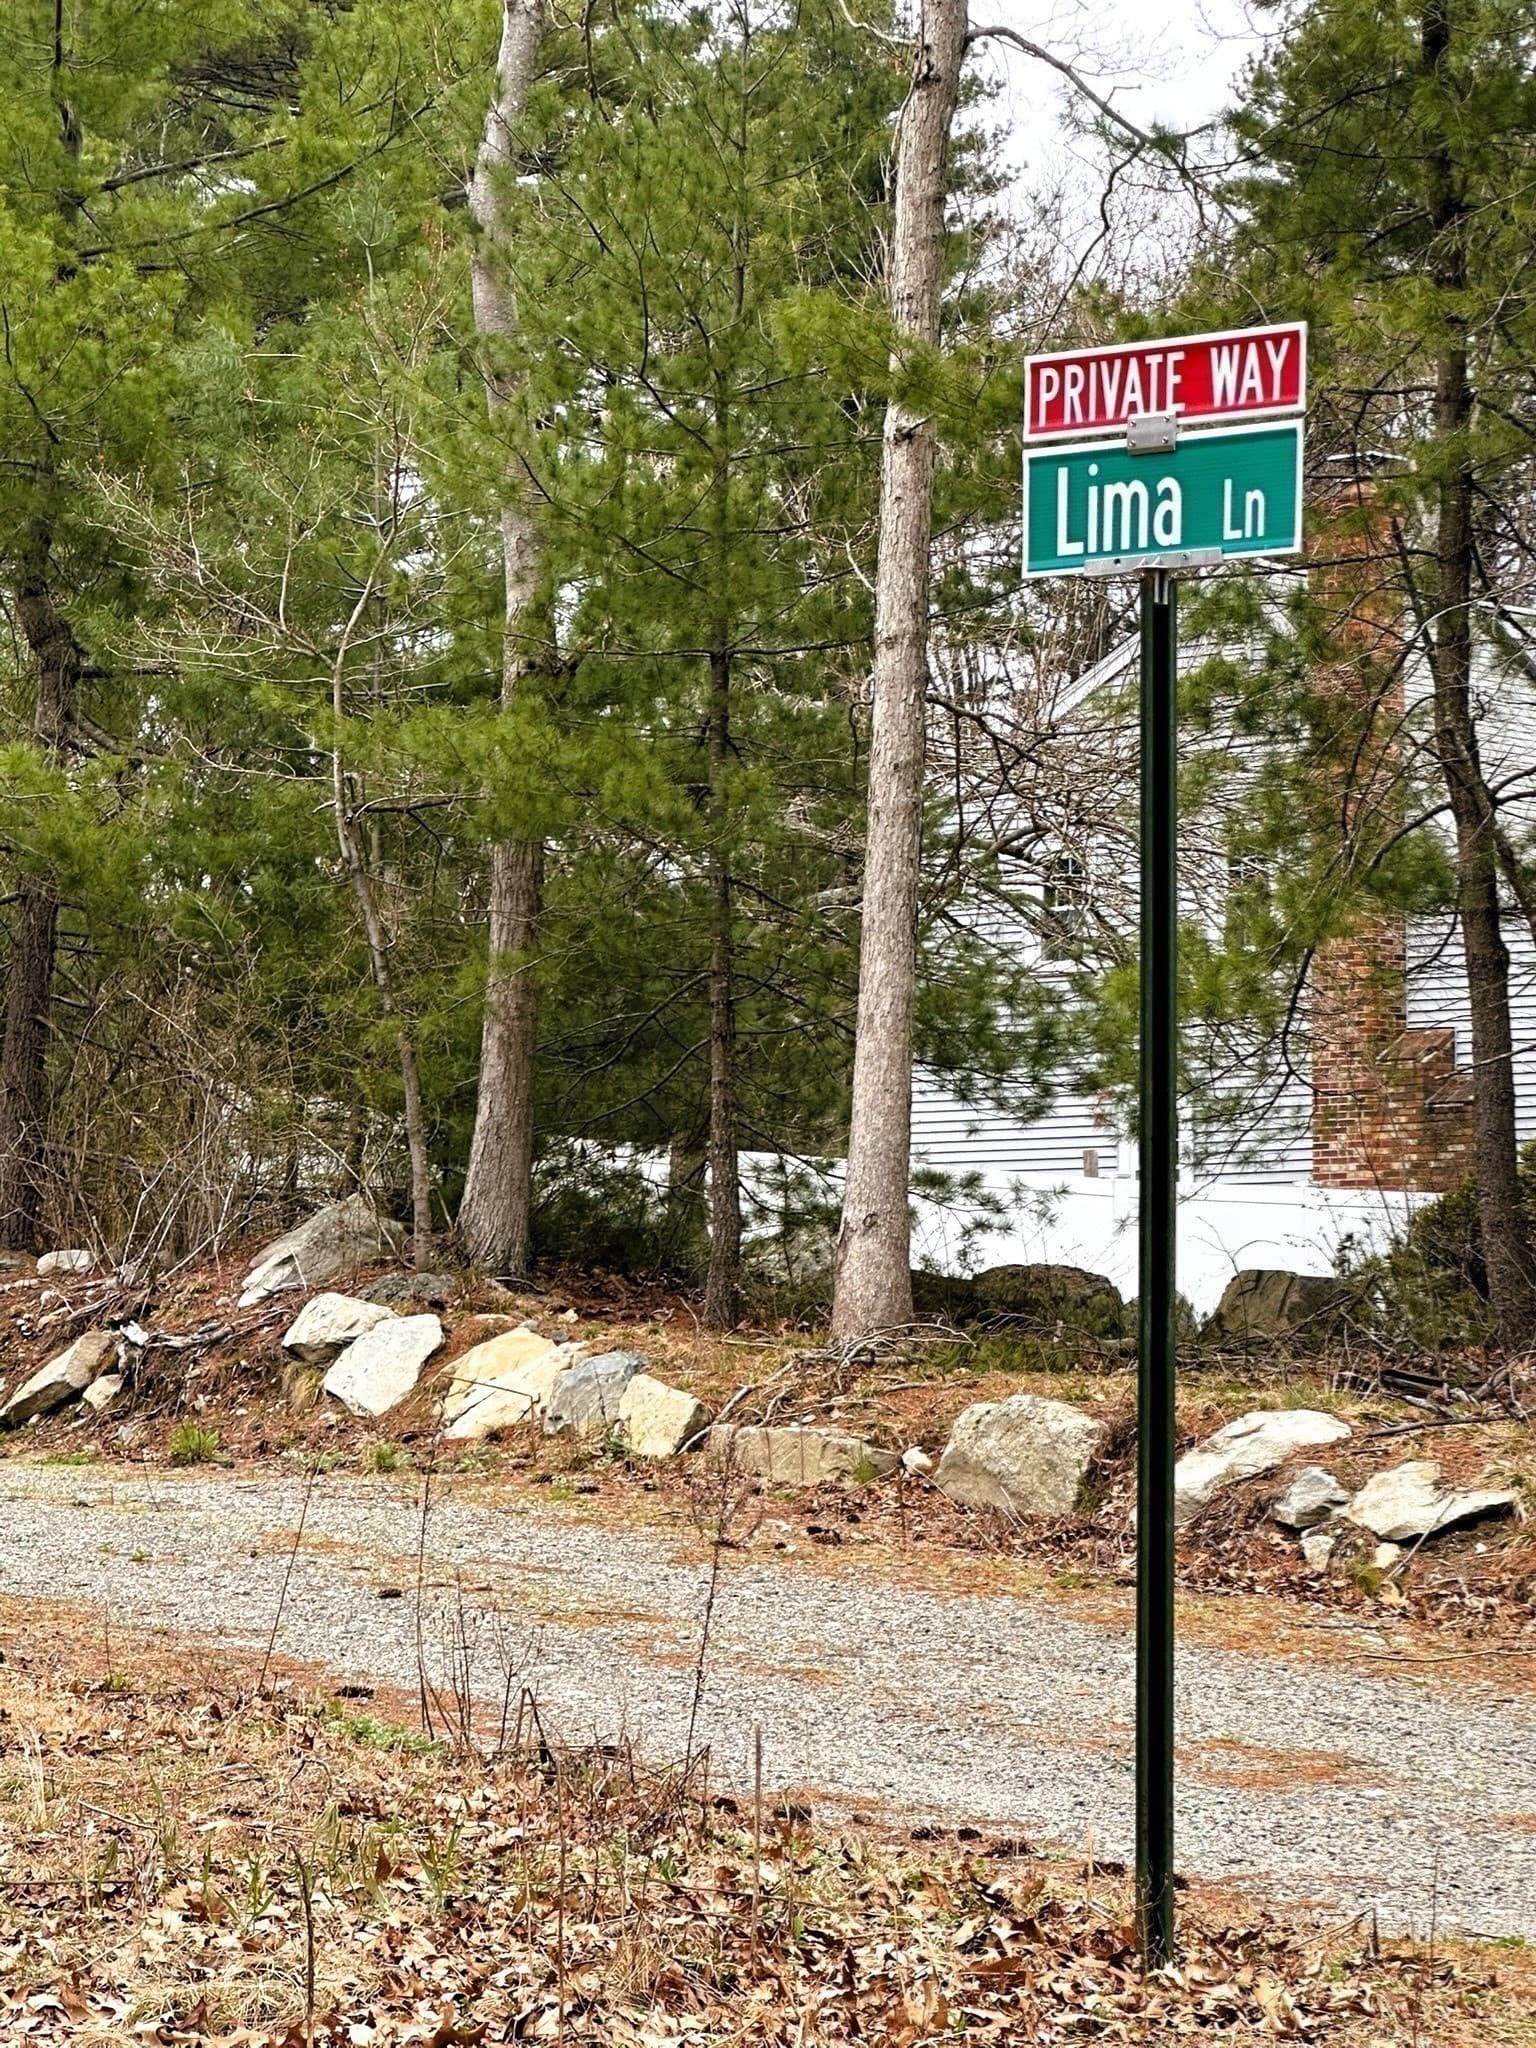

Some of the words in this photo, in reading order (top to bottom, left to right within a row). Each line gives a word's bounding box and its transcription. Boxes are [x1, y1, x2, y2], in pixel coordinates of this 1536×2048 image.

[1038, 351, 1186, 428] PRIVATE
[1210, 337, 1290, 408] WAY
[1056, 463, 1183, 557] Lima
[1223, 478, 1266, 541] Ln
